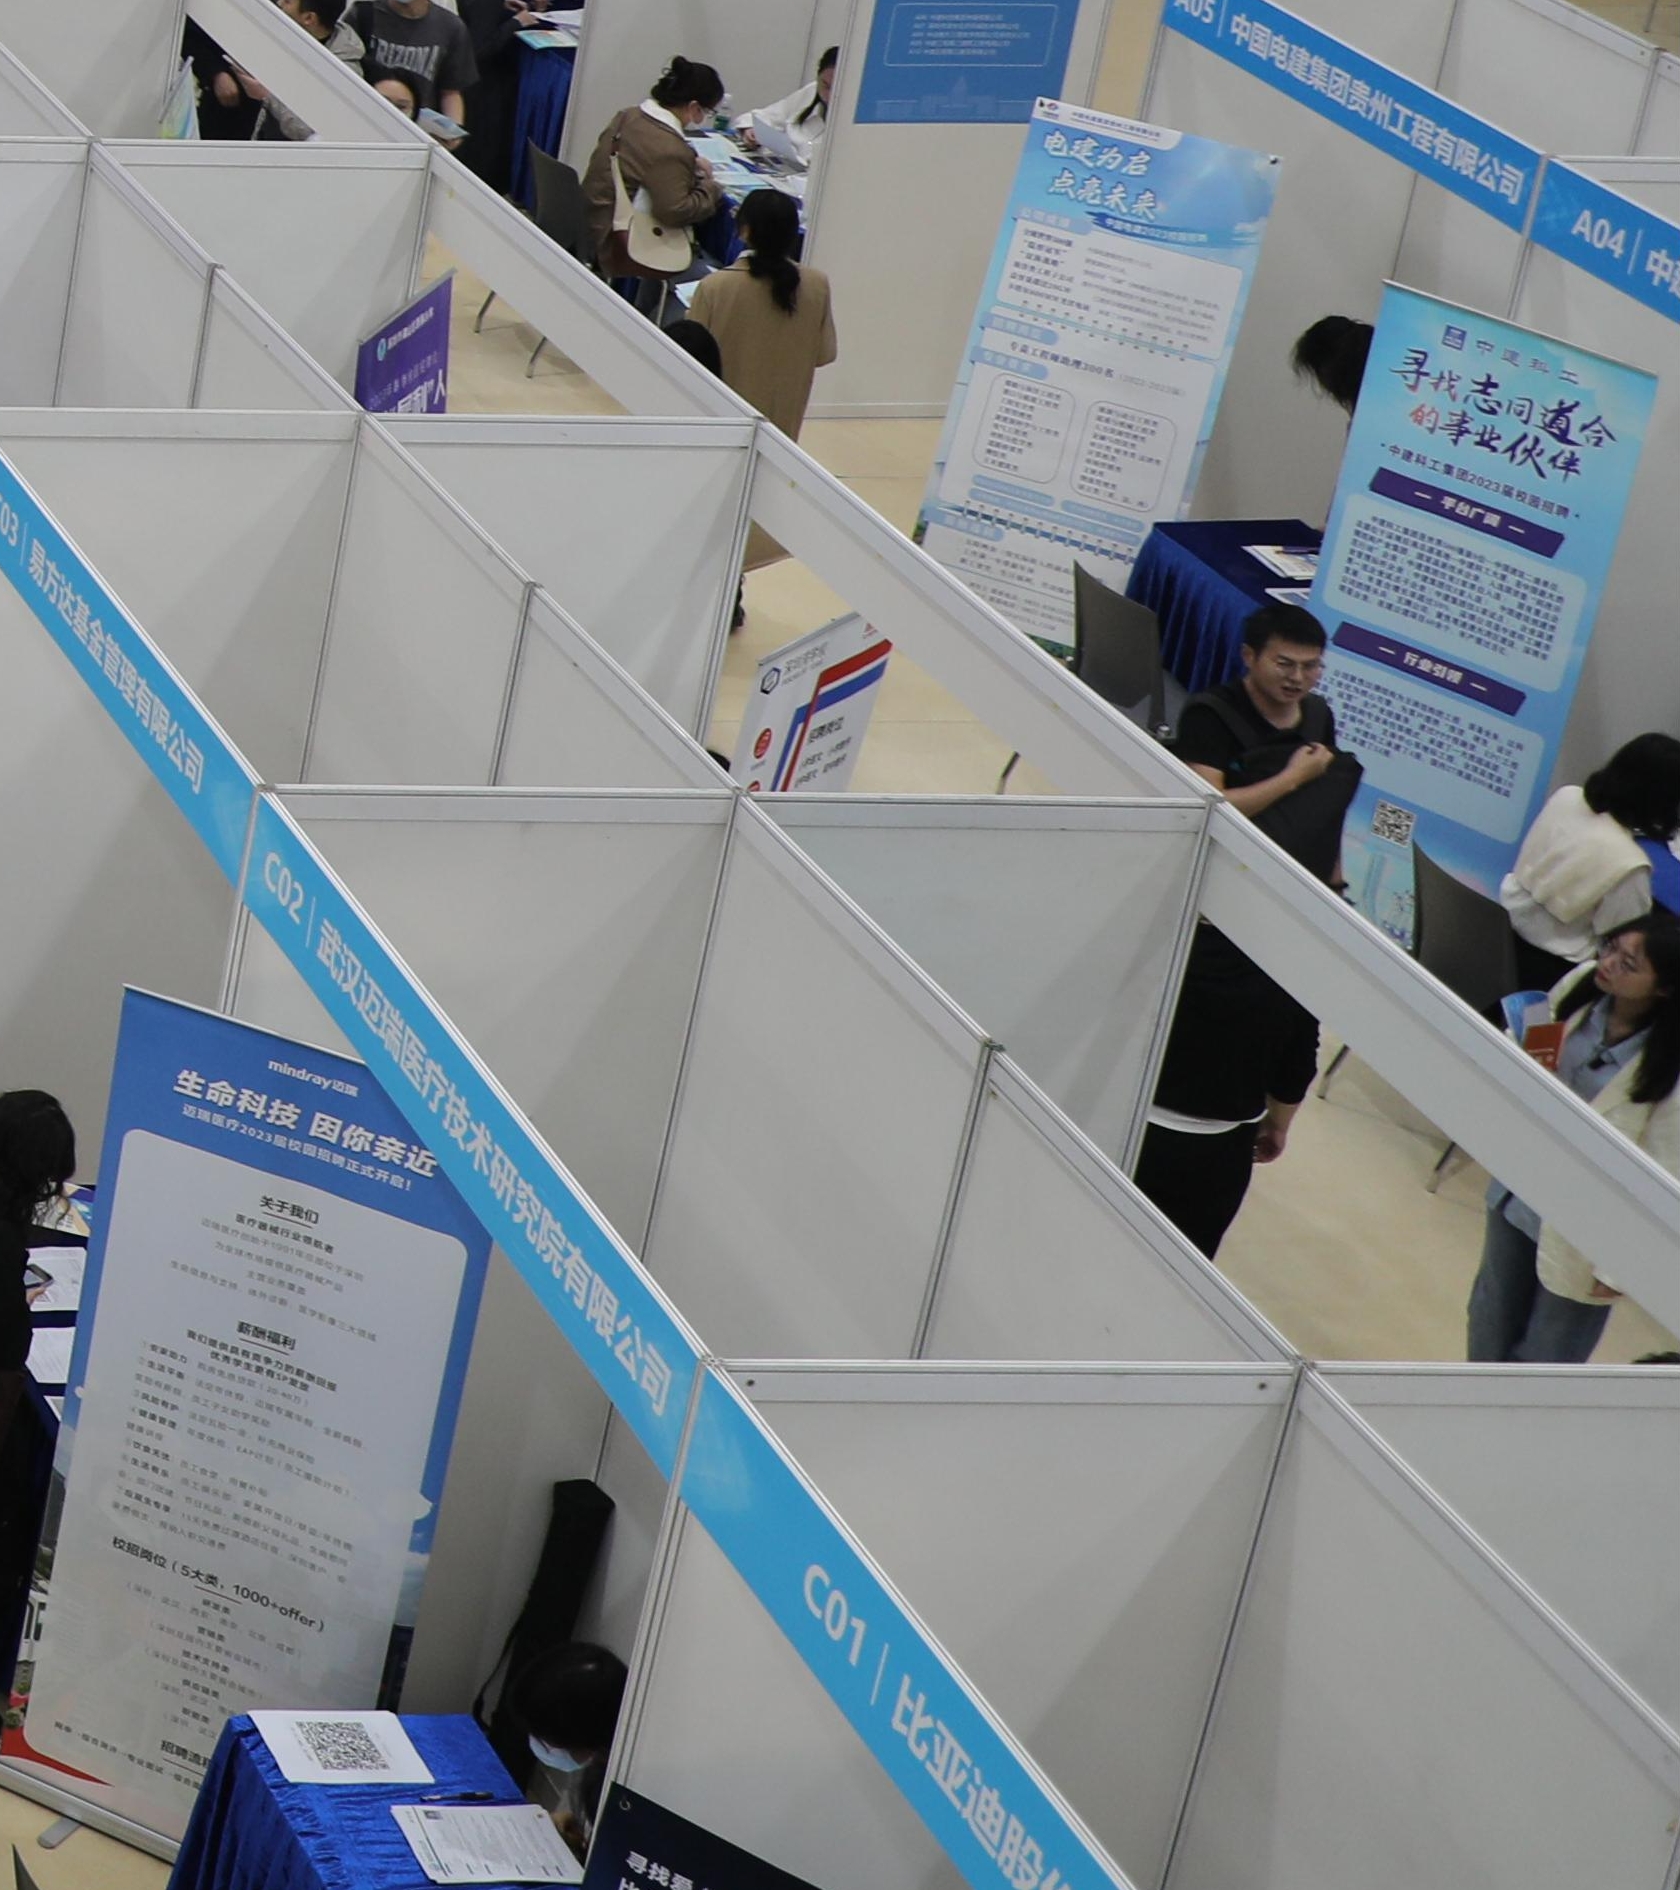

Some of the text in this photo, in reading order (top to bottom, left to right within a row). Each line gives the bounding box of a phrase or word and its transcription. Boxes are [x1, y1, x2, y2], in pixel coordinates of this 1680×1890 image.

[1229, 12, 1526, 208] 中国电建集团贵州工程有限公司
[1047, 169, 1160, 223] 点亮未来
[1571, 207, 1628, 261] A04
[1389, 347, 1620, 449] 寻找志同道合
[1474, 337, 1581, 386] 中建科工
[1408, 404, 1583, 482] 的事业伙伴
[27, 536, 206, 797] 易方达基金管理有限公司
[172, 1068, 439, 1180] 生命科技 因你亲近
[263, 850, 674, 1418] C02 武汉迈瑞医疗技术研究院有限公司
[258, 1192, 321, 1226] 关于我们
[236, 1320, 297, 1351] 薪酬福利
[802, 1563, 868, 1667] C01
